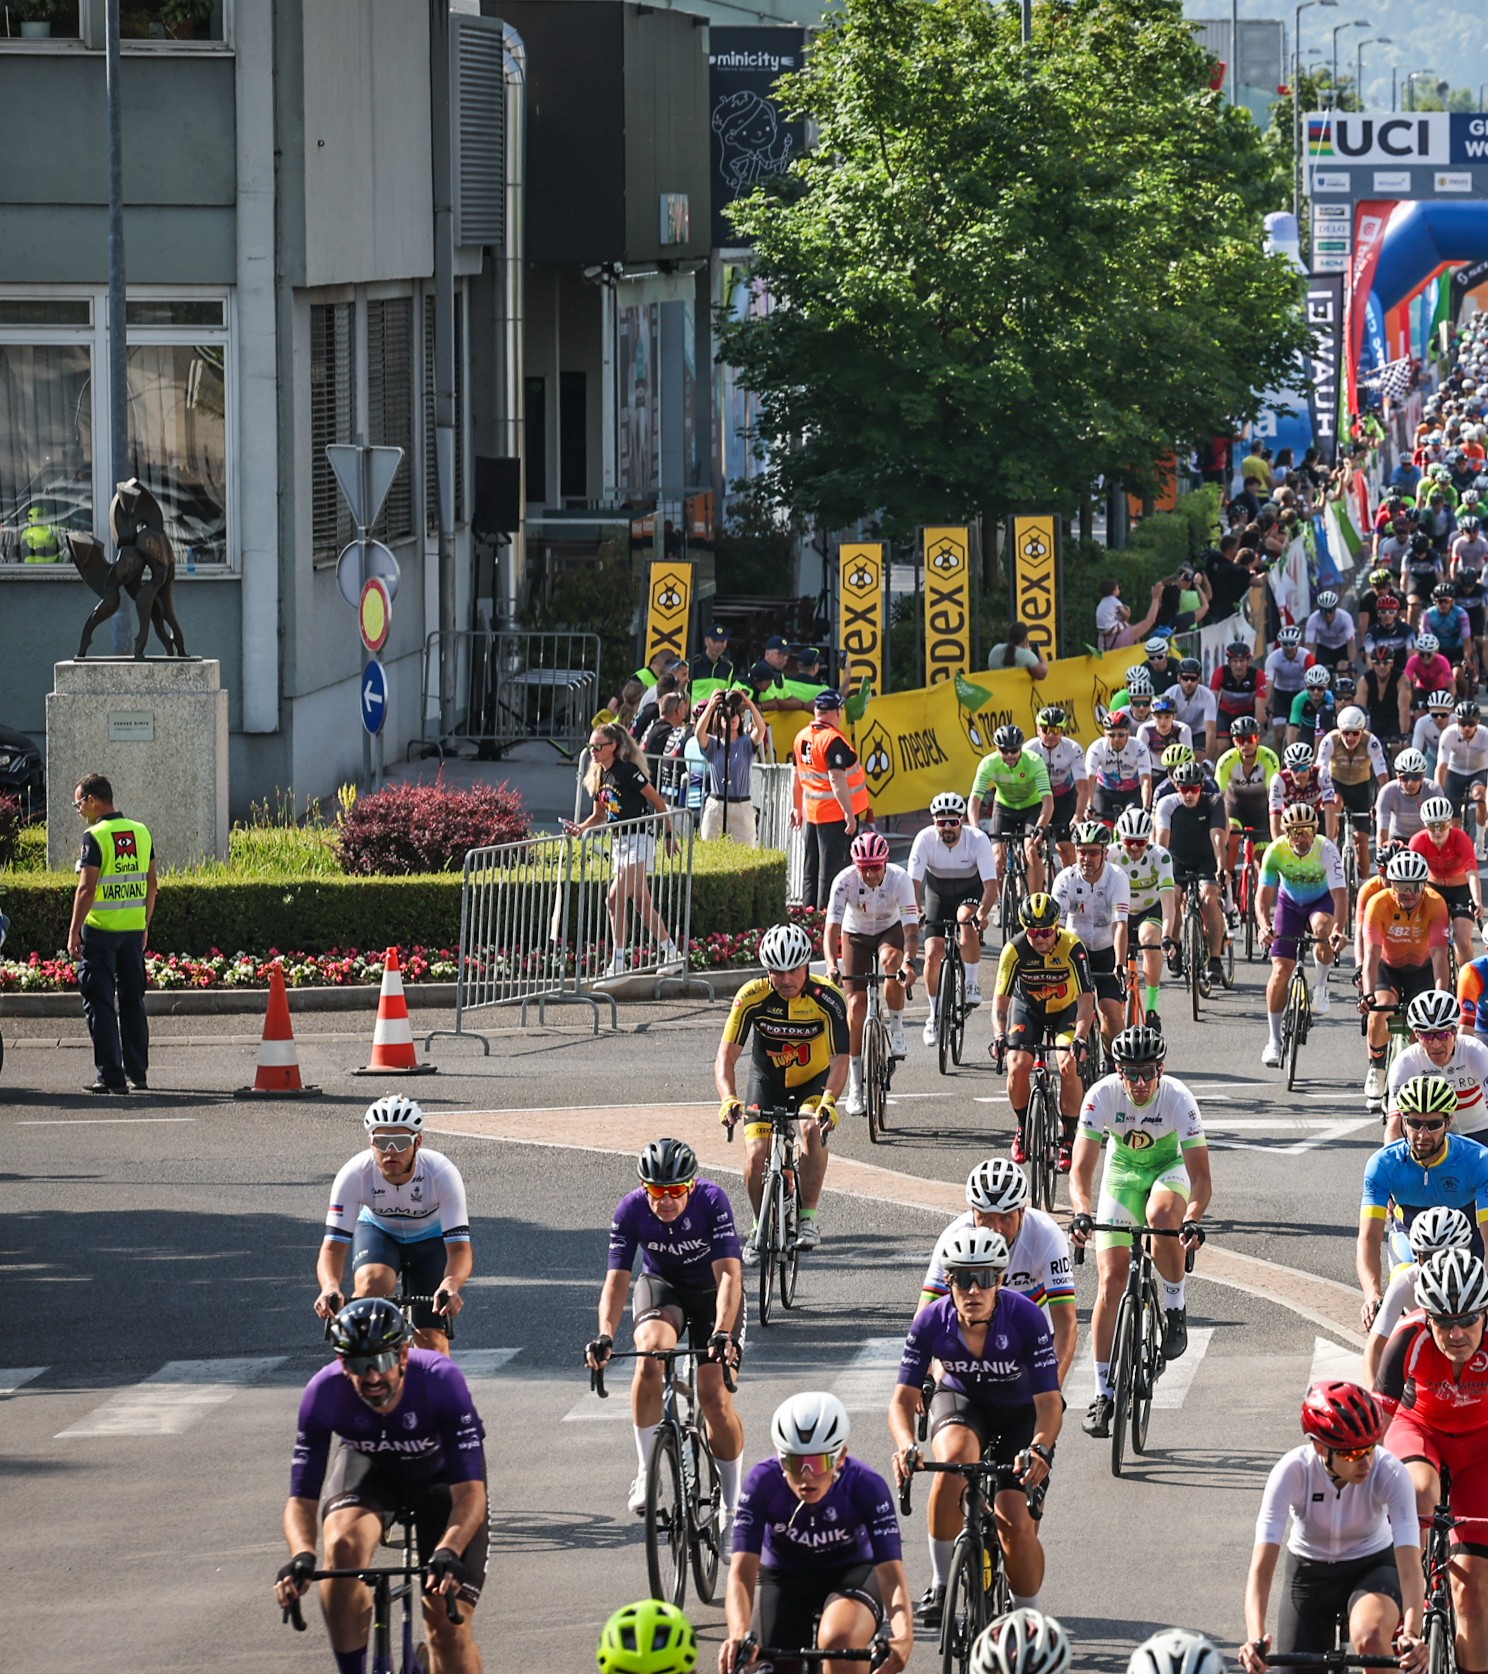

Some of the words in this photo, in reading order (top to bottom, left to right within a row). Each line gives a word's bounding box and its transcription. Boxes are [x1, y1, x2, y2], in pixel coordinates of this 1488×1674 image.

[717, 51, 779, 71] minicity
[1336, 120, 1429, 157] UCI
[115, 861, 139, 873] Sintal
[944, 1359, 1020, 1374] BRANIK
[341, 1437, 435, 1452] BRANIK
[773, 1522, 850, 1547] BRANIK
